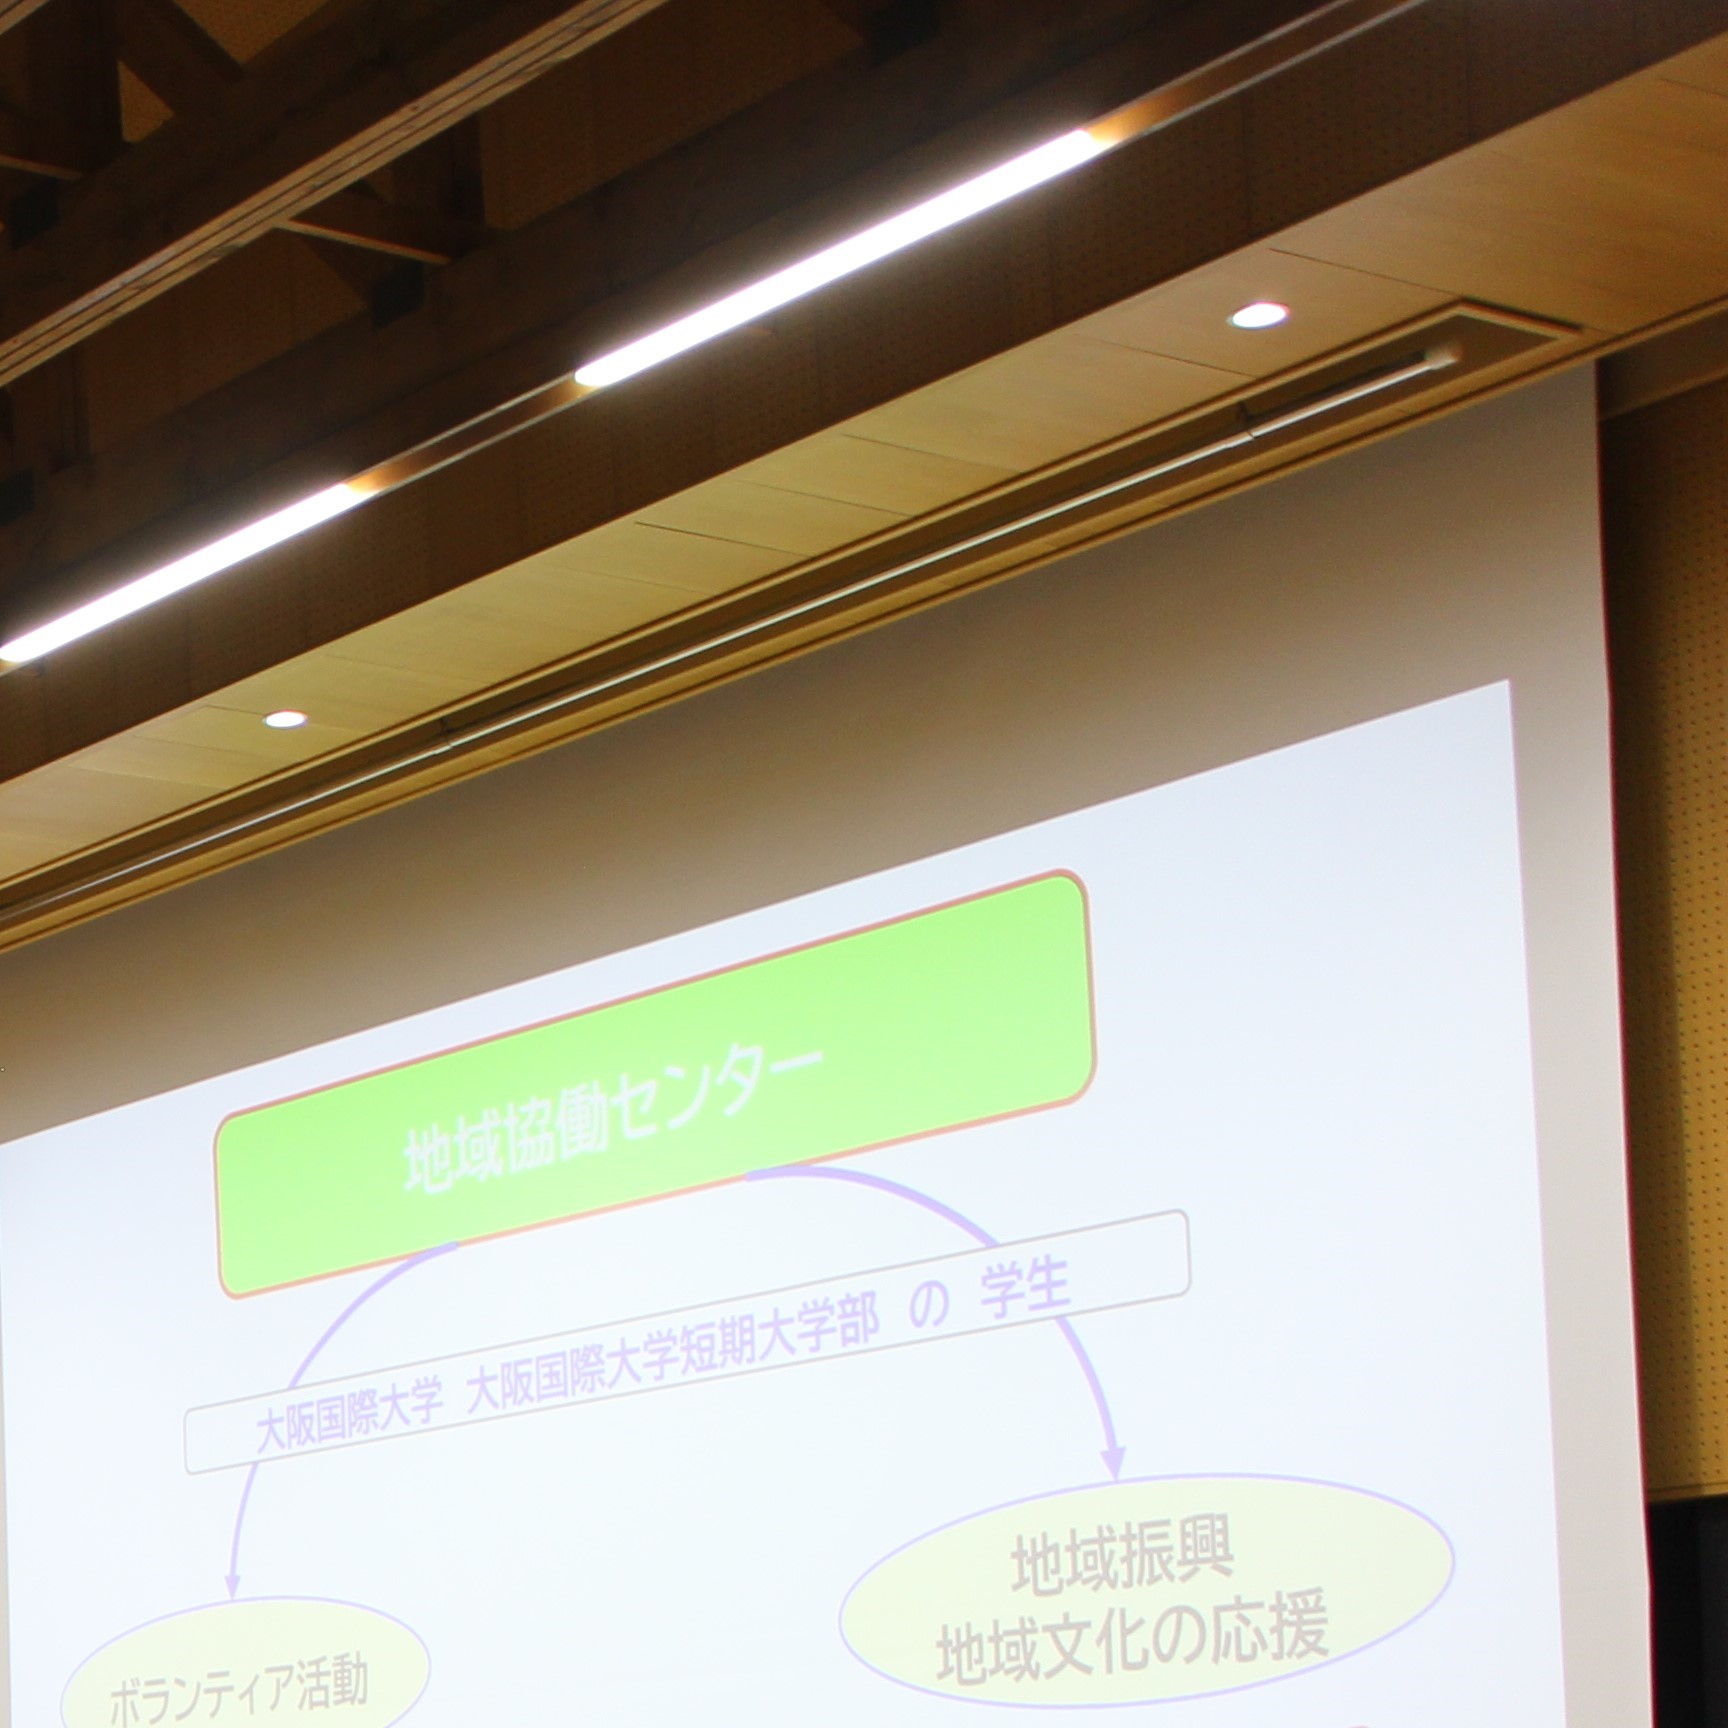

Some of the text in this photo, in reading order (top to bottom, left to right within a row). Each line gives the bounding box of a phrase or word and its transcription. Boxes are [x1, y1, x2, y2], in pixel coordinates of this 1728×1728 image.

[403, 1042, 823, 1194] 地域協働センター
[256, 1253, 1071, 1454] 大阪国際大学 大阪国際大学短期大学部 の 学生
[1010, 1512, 1235, 1598] 地域振興
[935, 1586, 1330, 1687] 地域文化の応援
[110, 1650, 368, 1728] ボランティア活動
